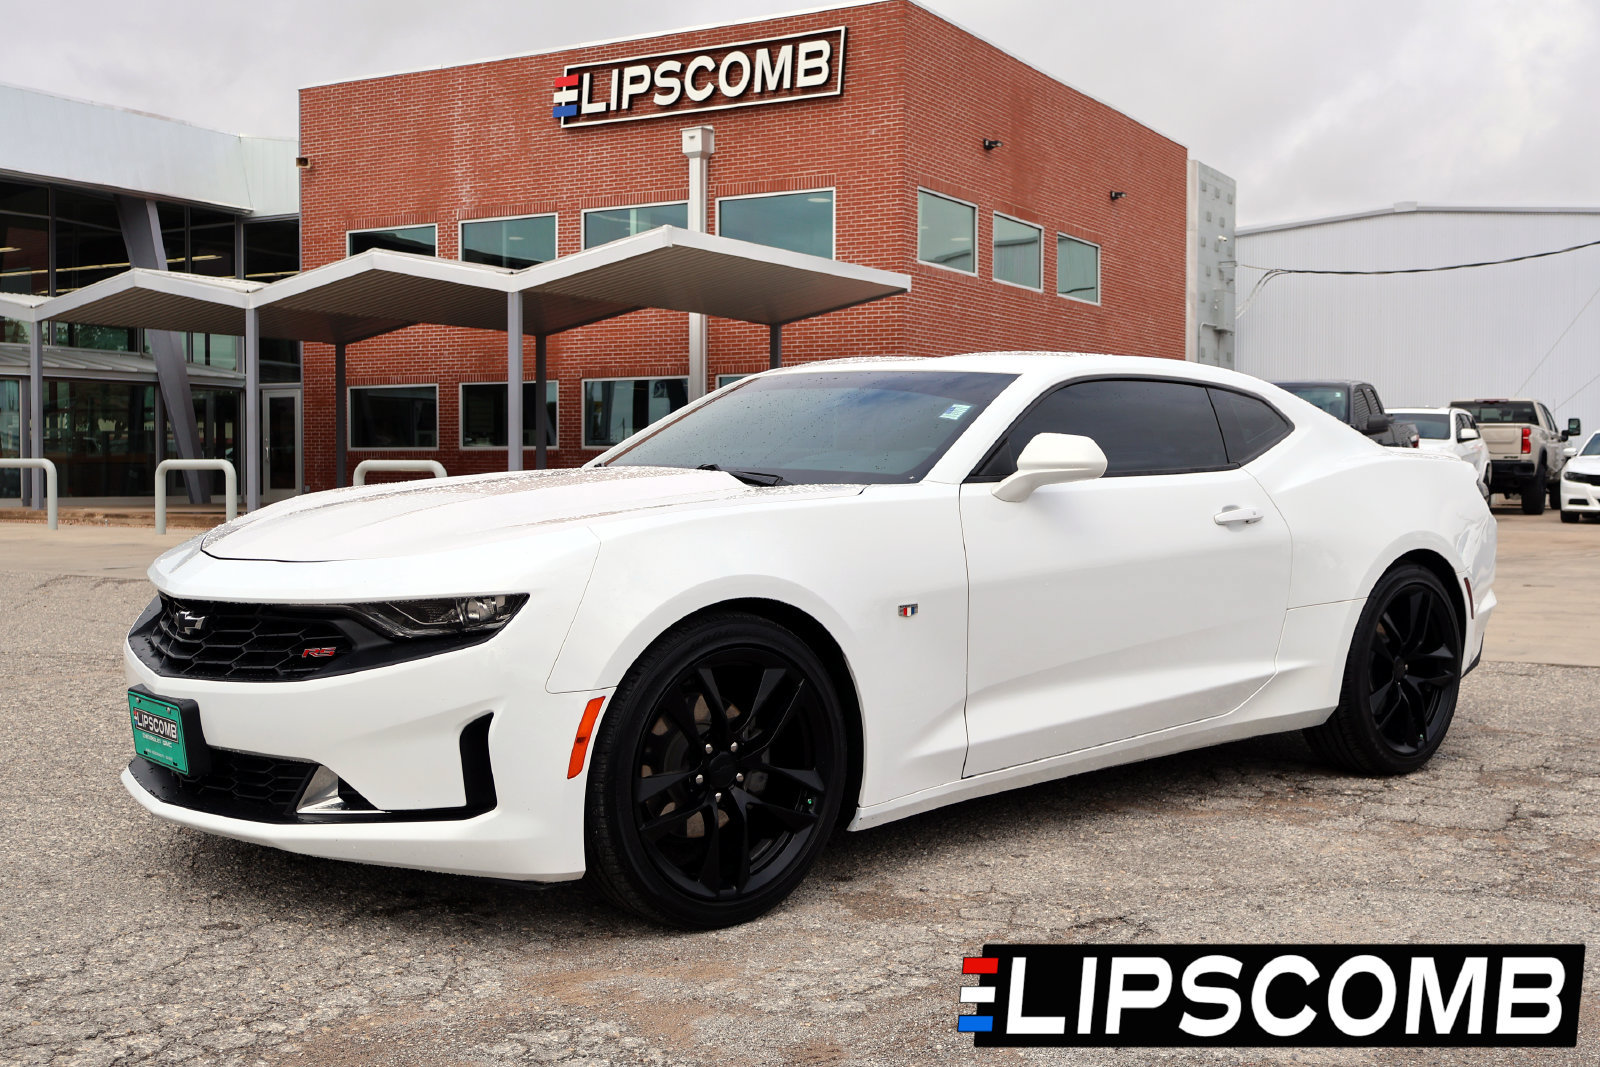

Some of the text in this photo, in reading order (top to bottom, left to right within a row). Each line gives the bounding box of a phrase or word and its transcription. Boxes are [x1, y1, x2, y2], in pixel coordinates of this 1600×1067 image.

[581, 39, 831, 115] LIPSCOMB
[301, 647, 337, 659] RS
[137, 711, 177, 739] LIPSCOMB
